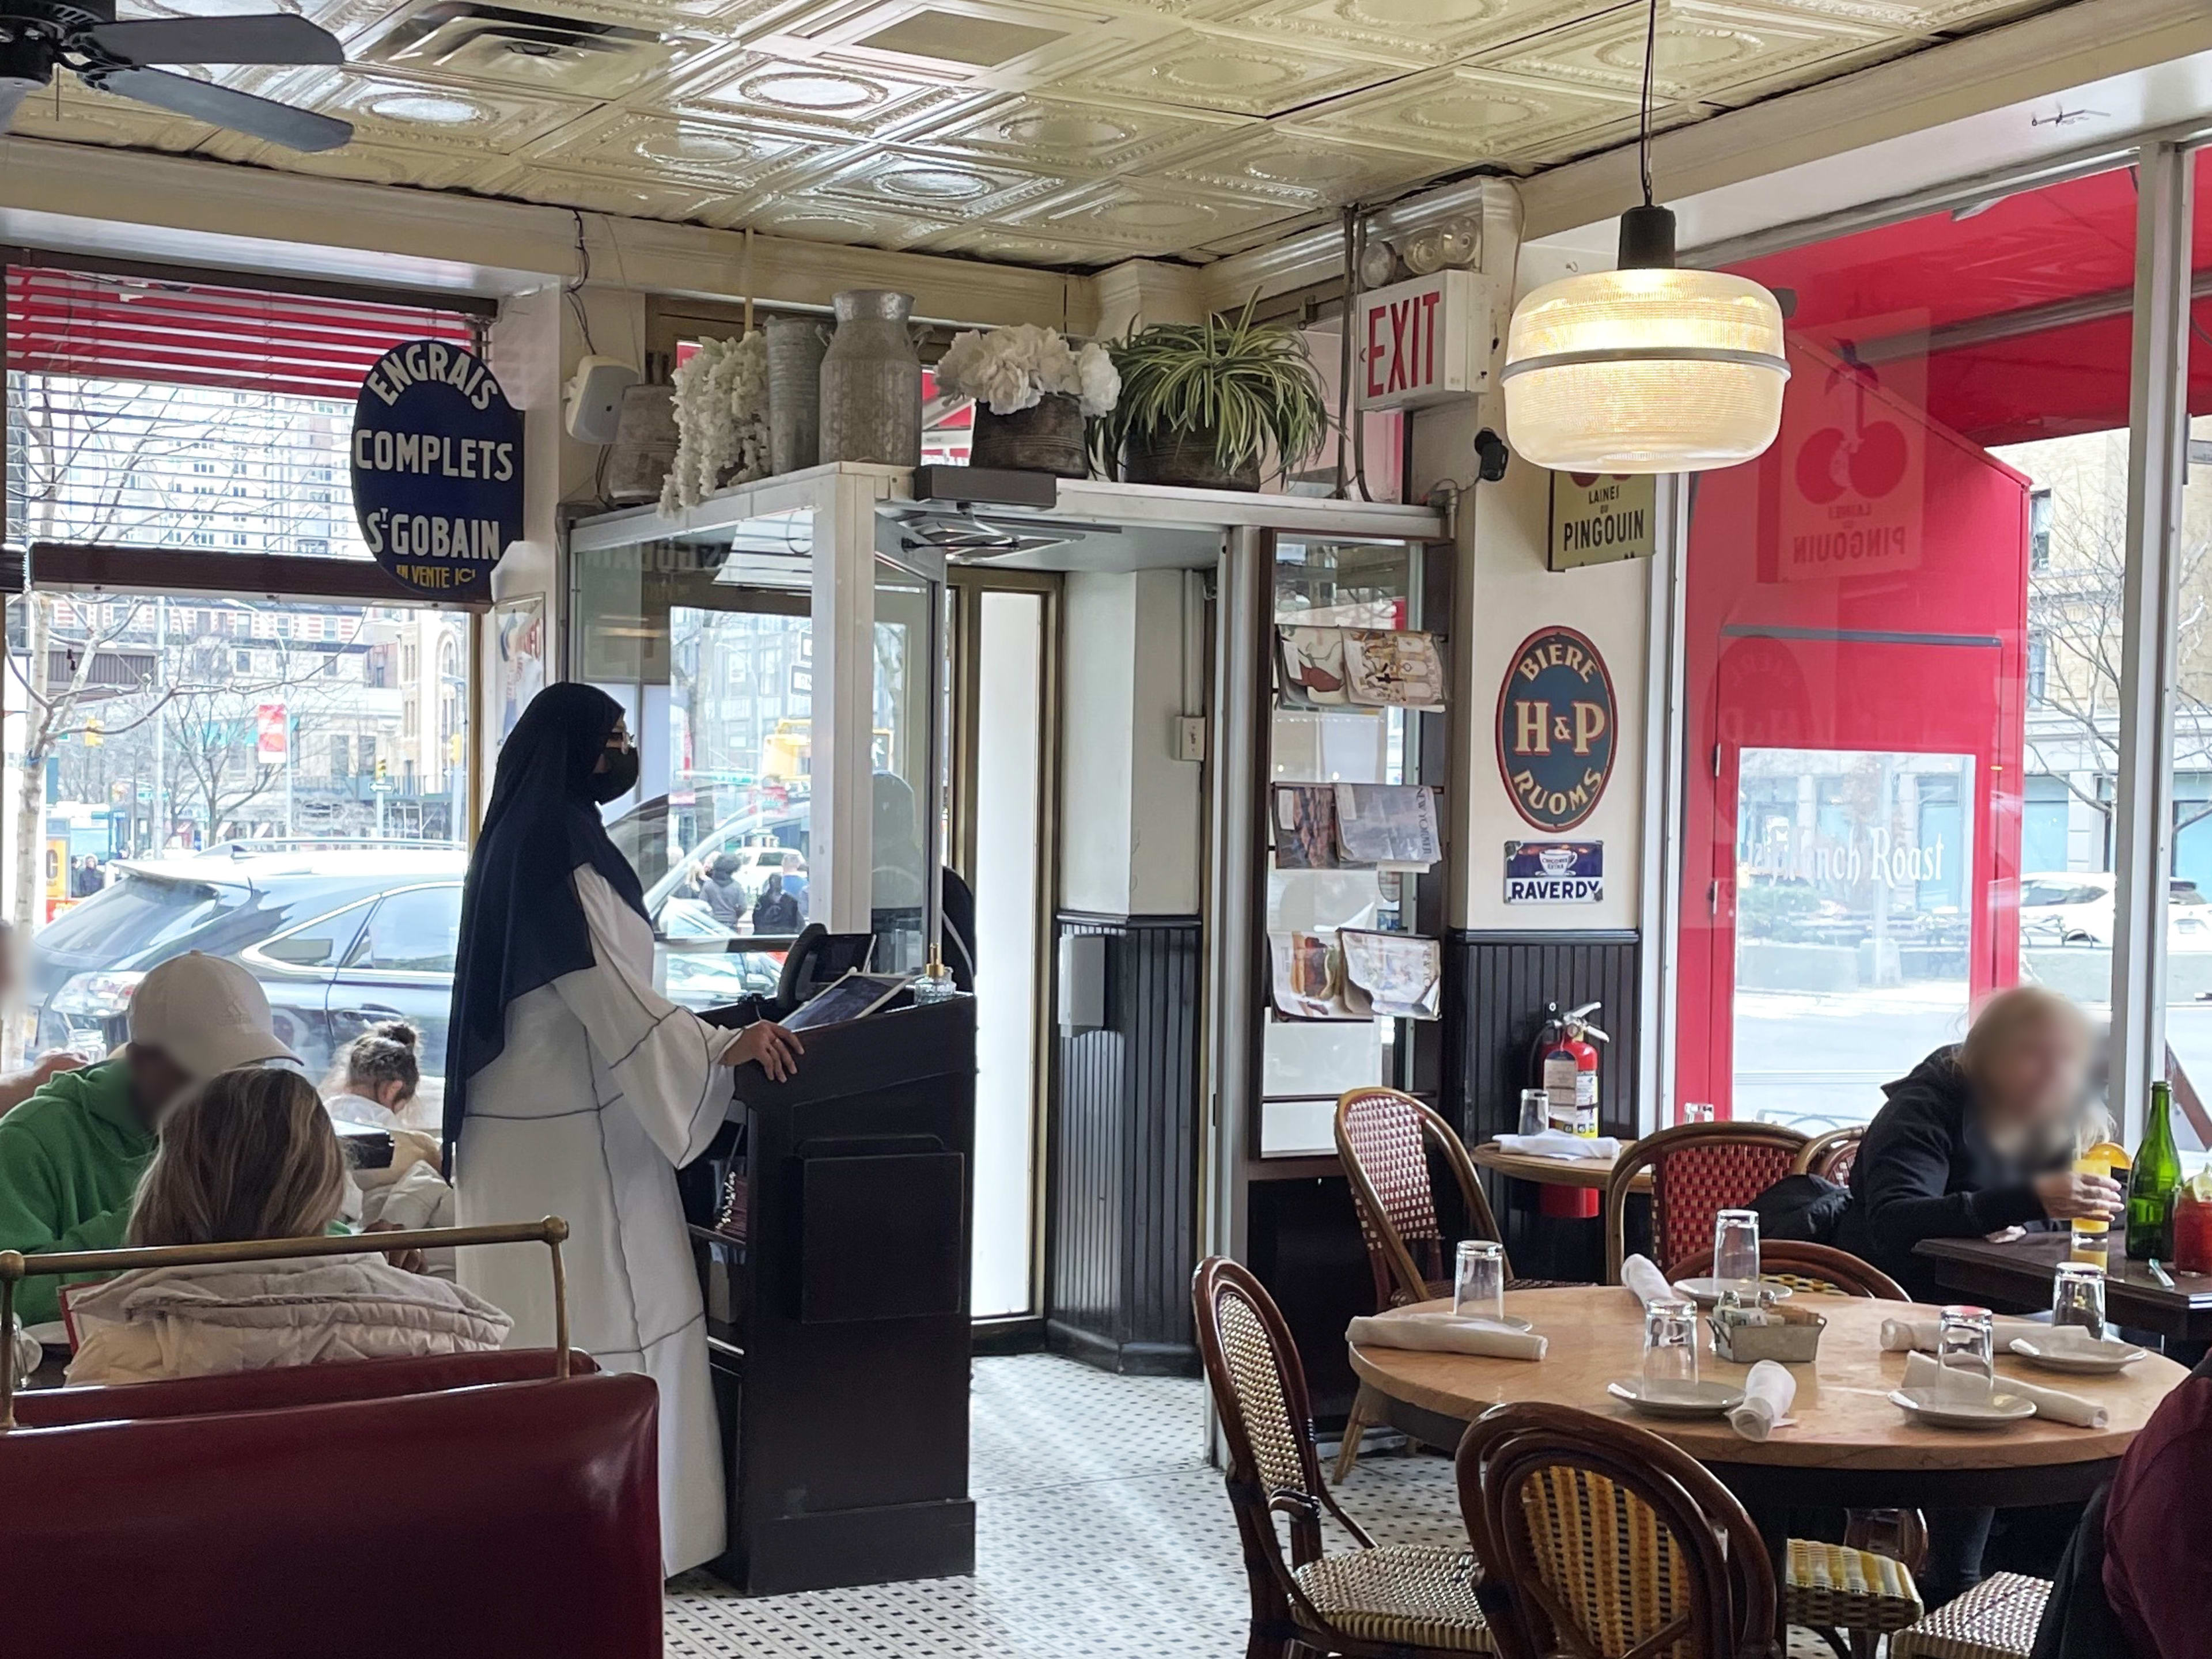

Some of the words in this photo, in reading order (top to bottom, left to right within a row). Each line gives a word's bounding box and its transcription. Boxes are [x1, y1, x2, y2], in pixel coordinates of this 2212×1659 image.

[1368, 291, 1440, 397] EXIT
[367, 344, 498, 410] ENGRAIS
[355, 429, 513, 482] COMPLETS
[1589, 485, 1619, 505] LAINES
[392, 514, 499, 560] GOBAIN
[1564, 509, 1643, 551] PINGOUIN
[411, 565, 450, 588] VENTE
[1513, 768, 1601, 815] RUOMS
[1870, 827, 1945, 889] Roast
[1512, 881, 1600, 900] RAVERDY
